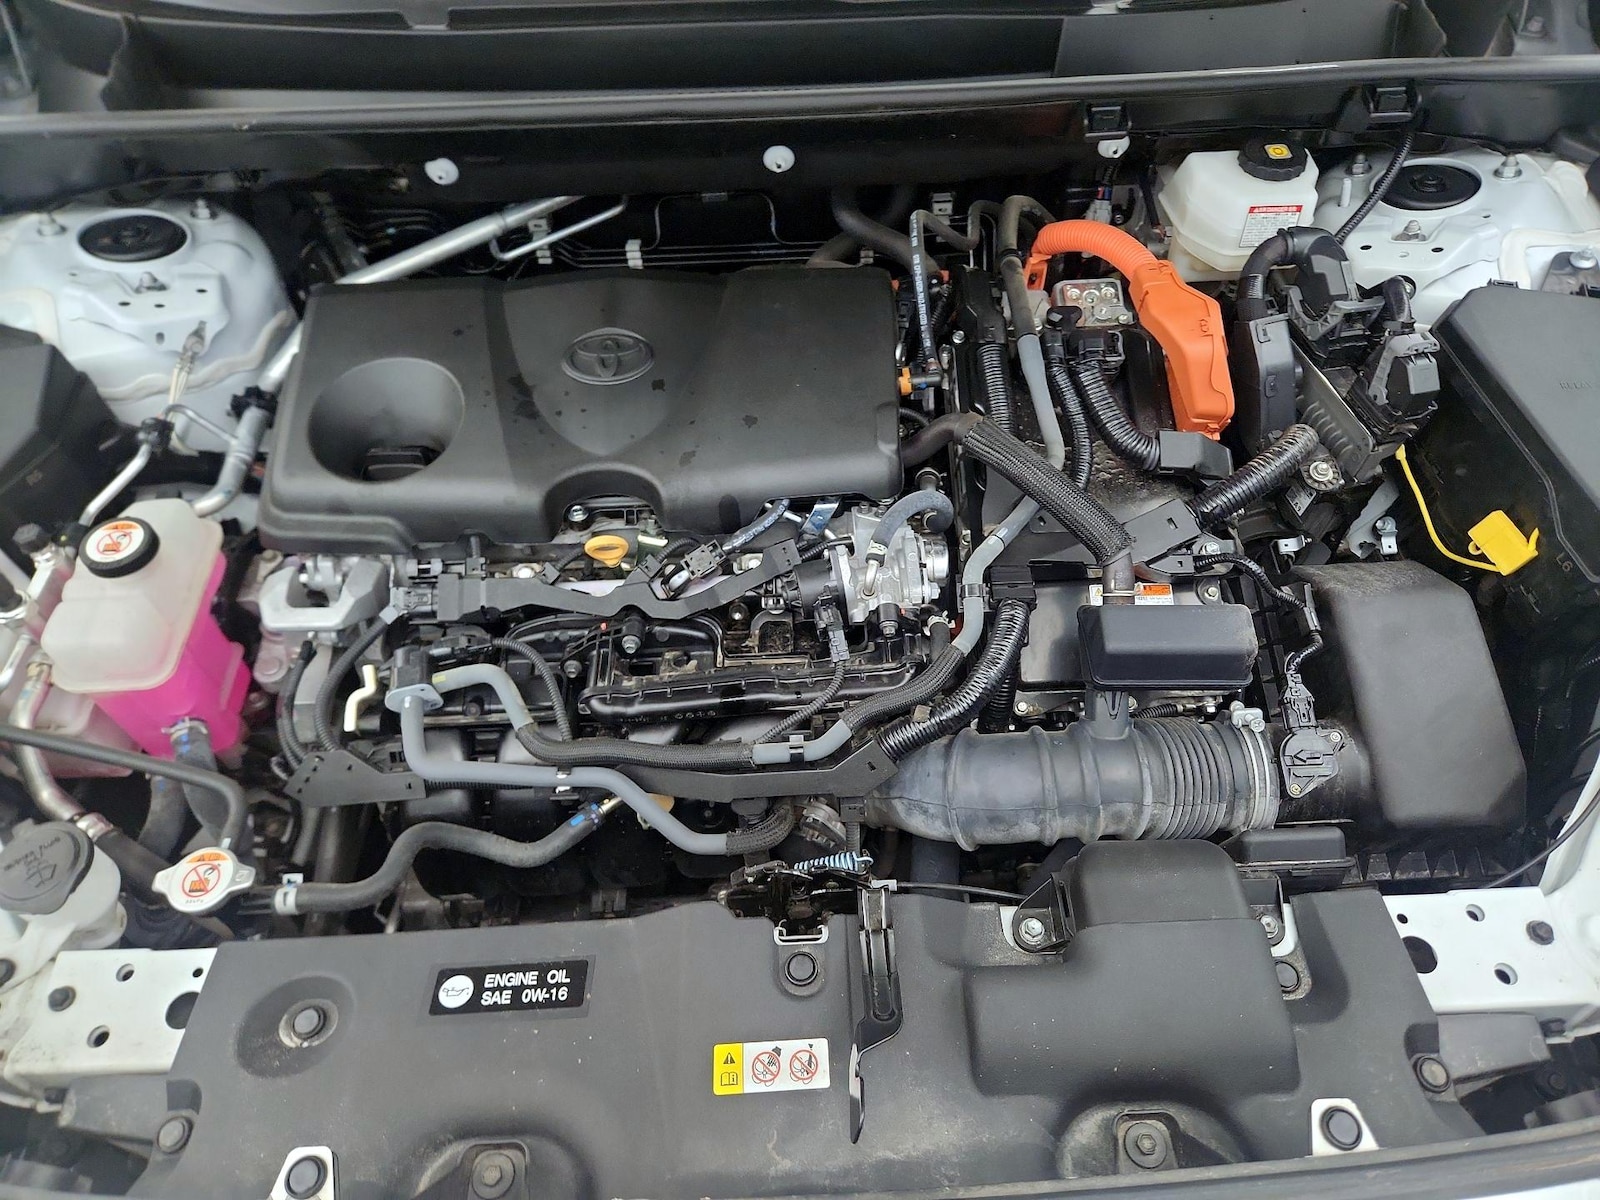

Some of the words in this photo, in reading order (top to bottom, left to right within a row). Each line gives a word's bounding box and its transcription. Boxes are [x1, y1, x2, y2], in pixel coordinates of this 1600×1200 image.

[484, 971, 539, 988] ENGINE
[547, 970, 571, 985] OIL
[480, 989, 512, 1006] SAE
[522, 987, 569, 1003] 0W-16
